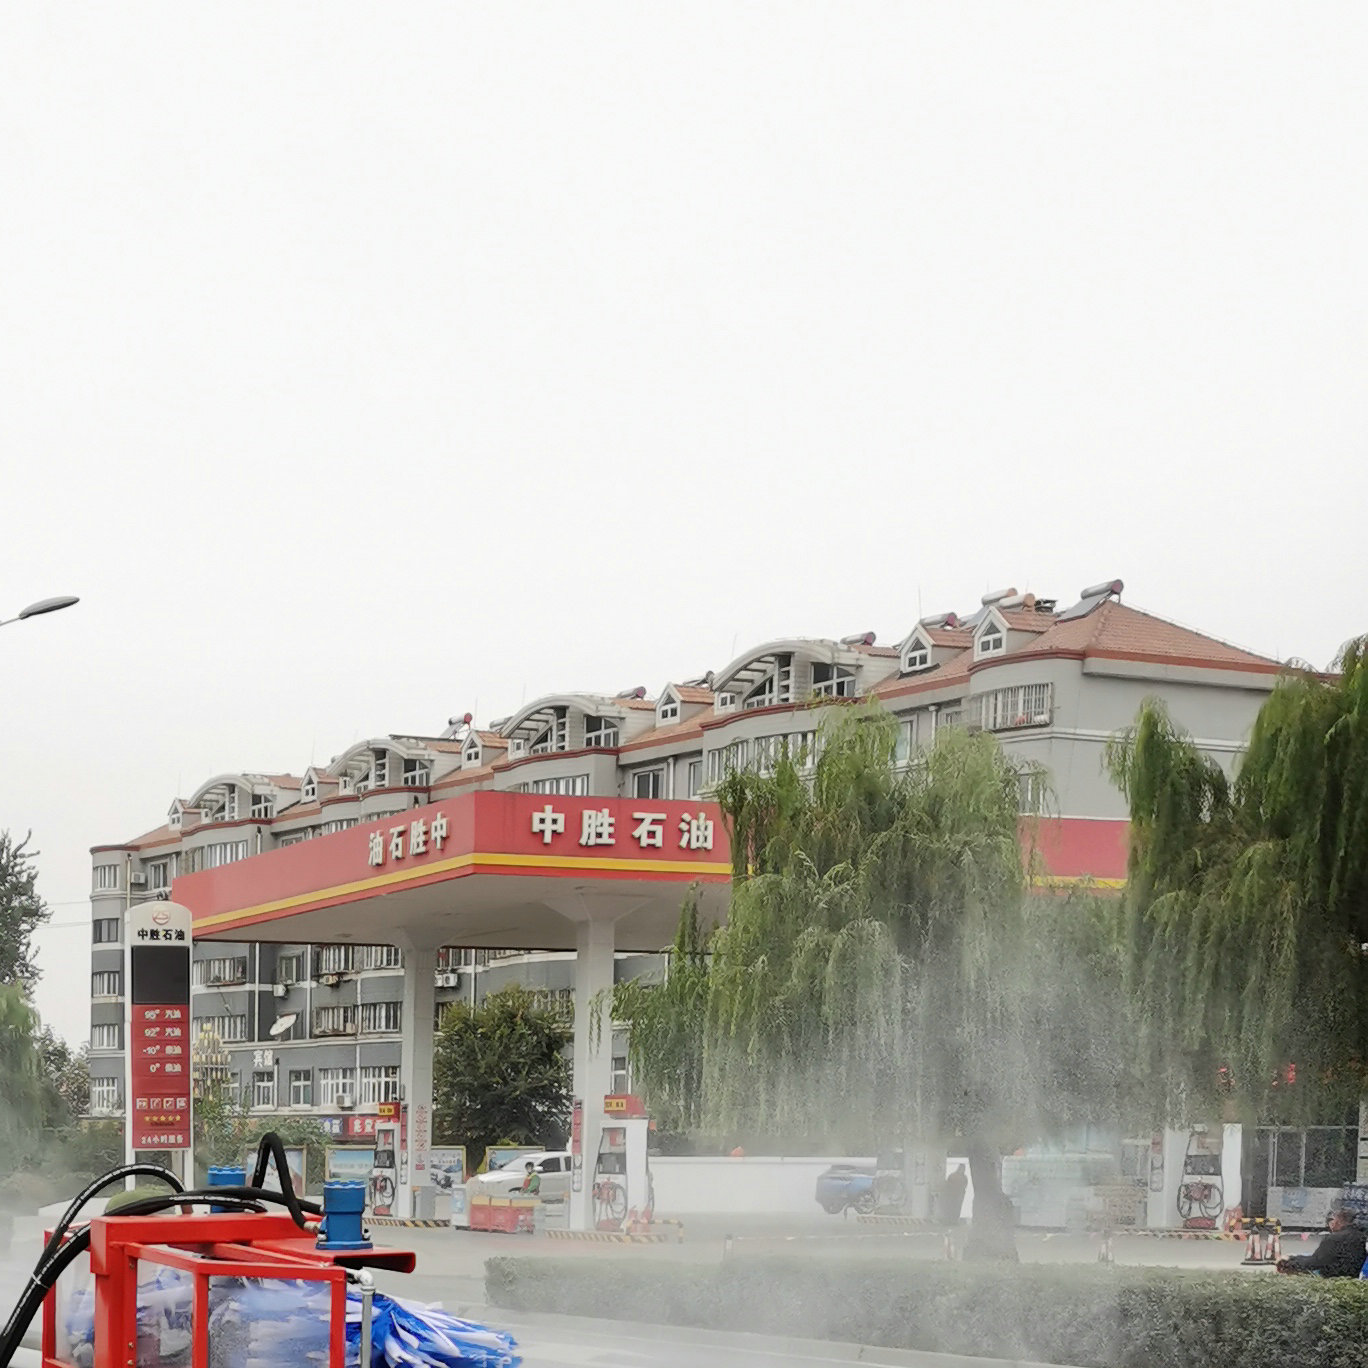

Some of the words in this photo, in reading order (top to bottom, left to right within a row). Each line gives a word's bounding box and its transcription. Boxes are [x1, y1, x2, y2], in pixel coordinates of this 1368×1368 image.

[532, 805, 714, 850] 中胜石油
[137, 927, 185, 940] 中胜石油
